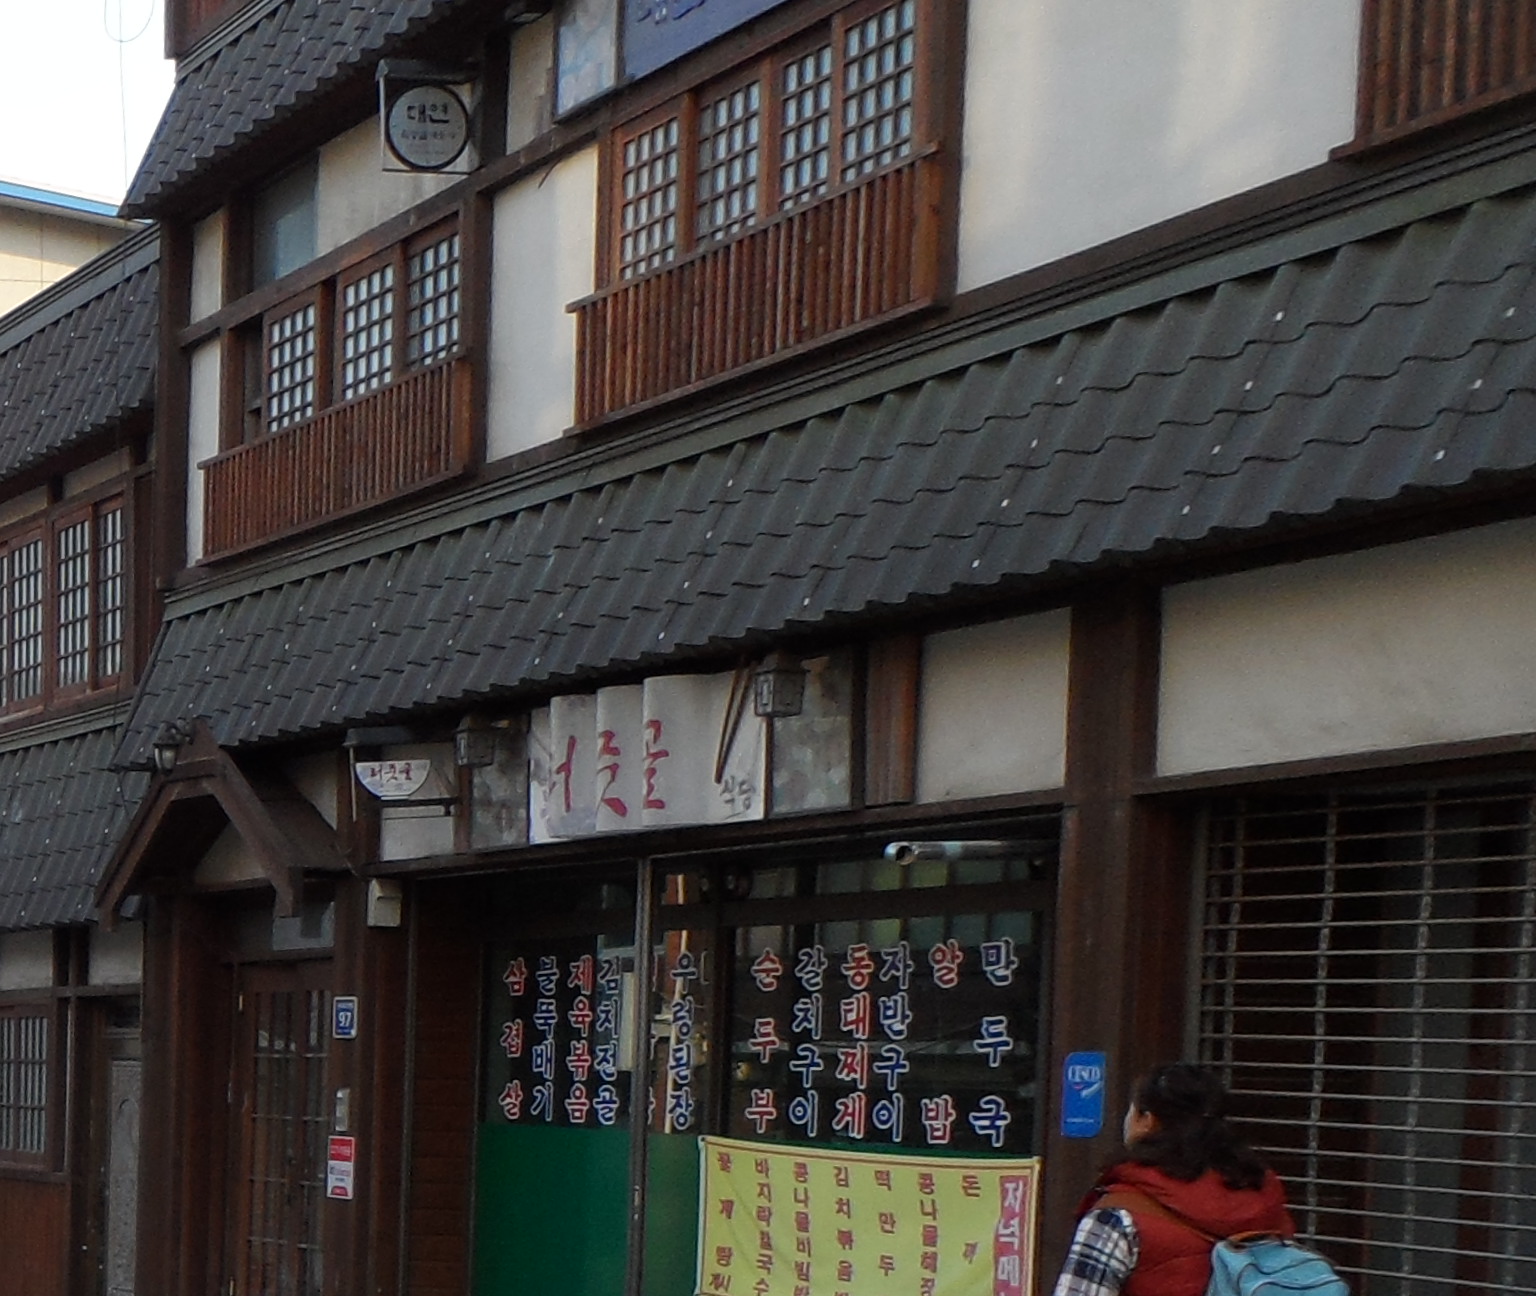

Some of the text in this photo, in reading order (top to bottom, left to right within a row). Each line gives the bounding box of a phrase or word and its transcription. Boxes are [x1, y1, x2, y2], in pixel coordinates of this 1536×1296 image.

[338, 1011, 352, 1027] 97
[498, 956, 528, 1121] 삼겹살
[564, 954, 595, 1124] 제육볶음
[592, 955, 621, 1126] 김치전골
[667, 951, 698, 1131] 우렁된장
[745, 947, 783, 1135] 순두부
[787, 944, 829, 1138] 갈치구이
[871, 940, 915, 1143] 자반구이
[920, 938, 964, 1145] 알밥
[968, 936, 1020, 1148] 만두국
